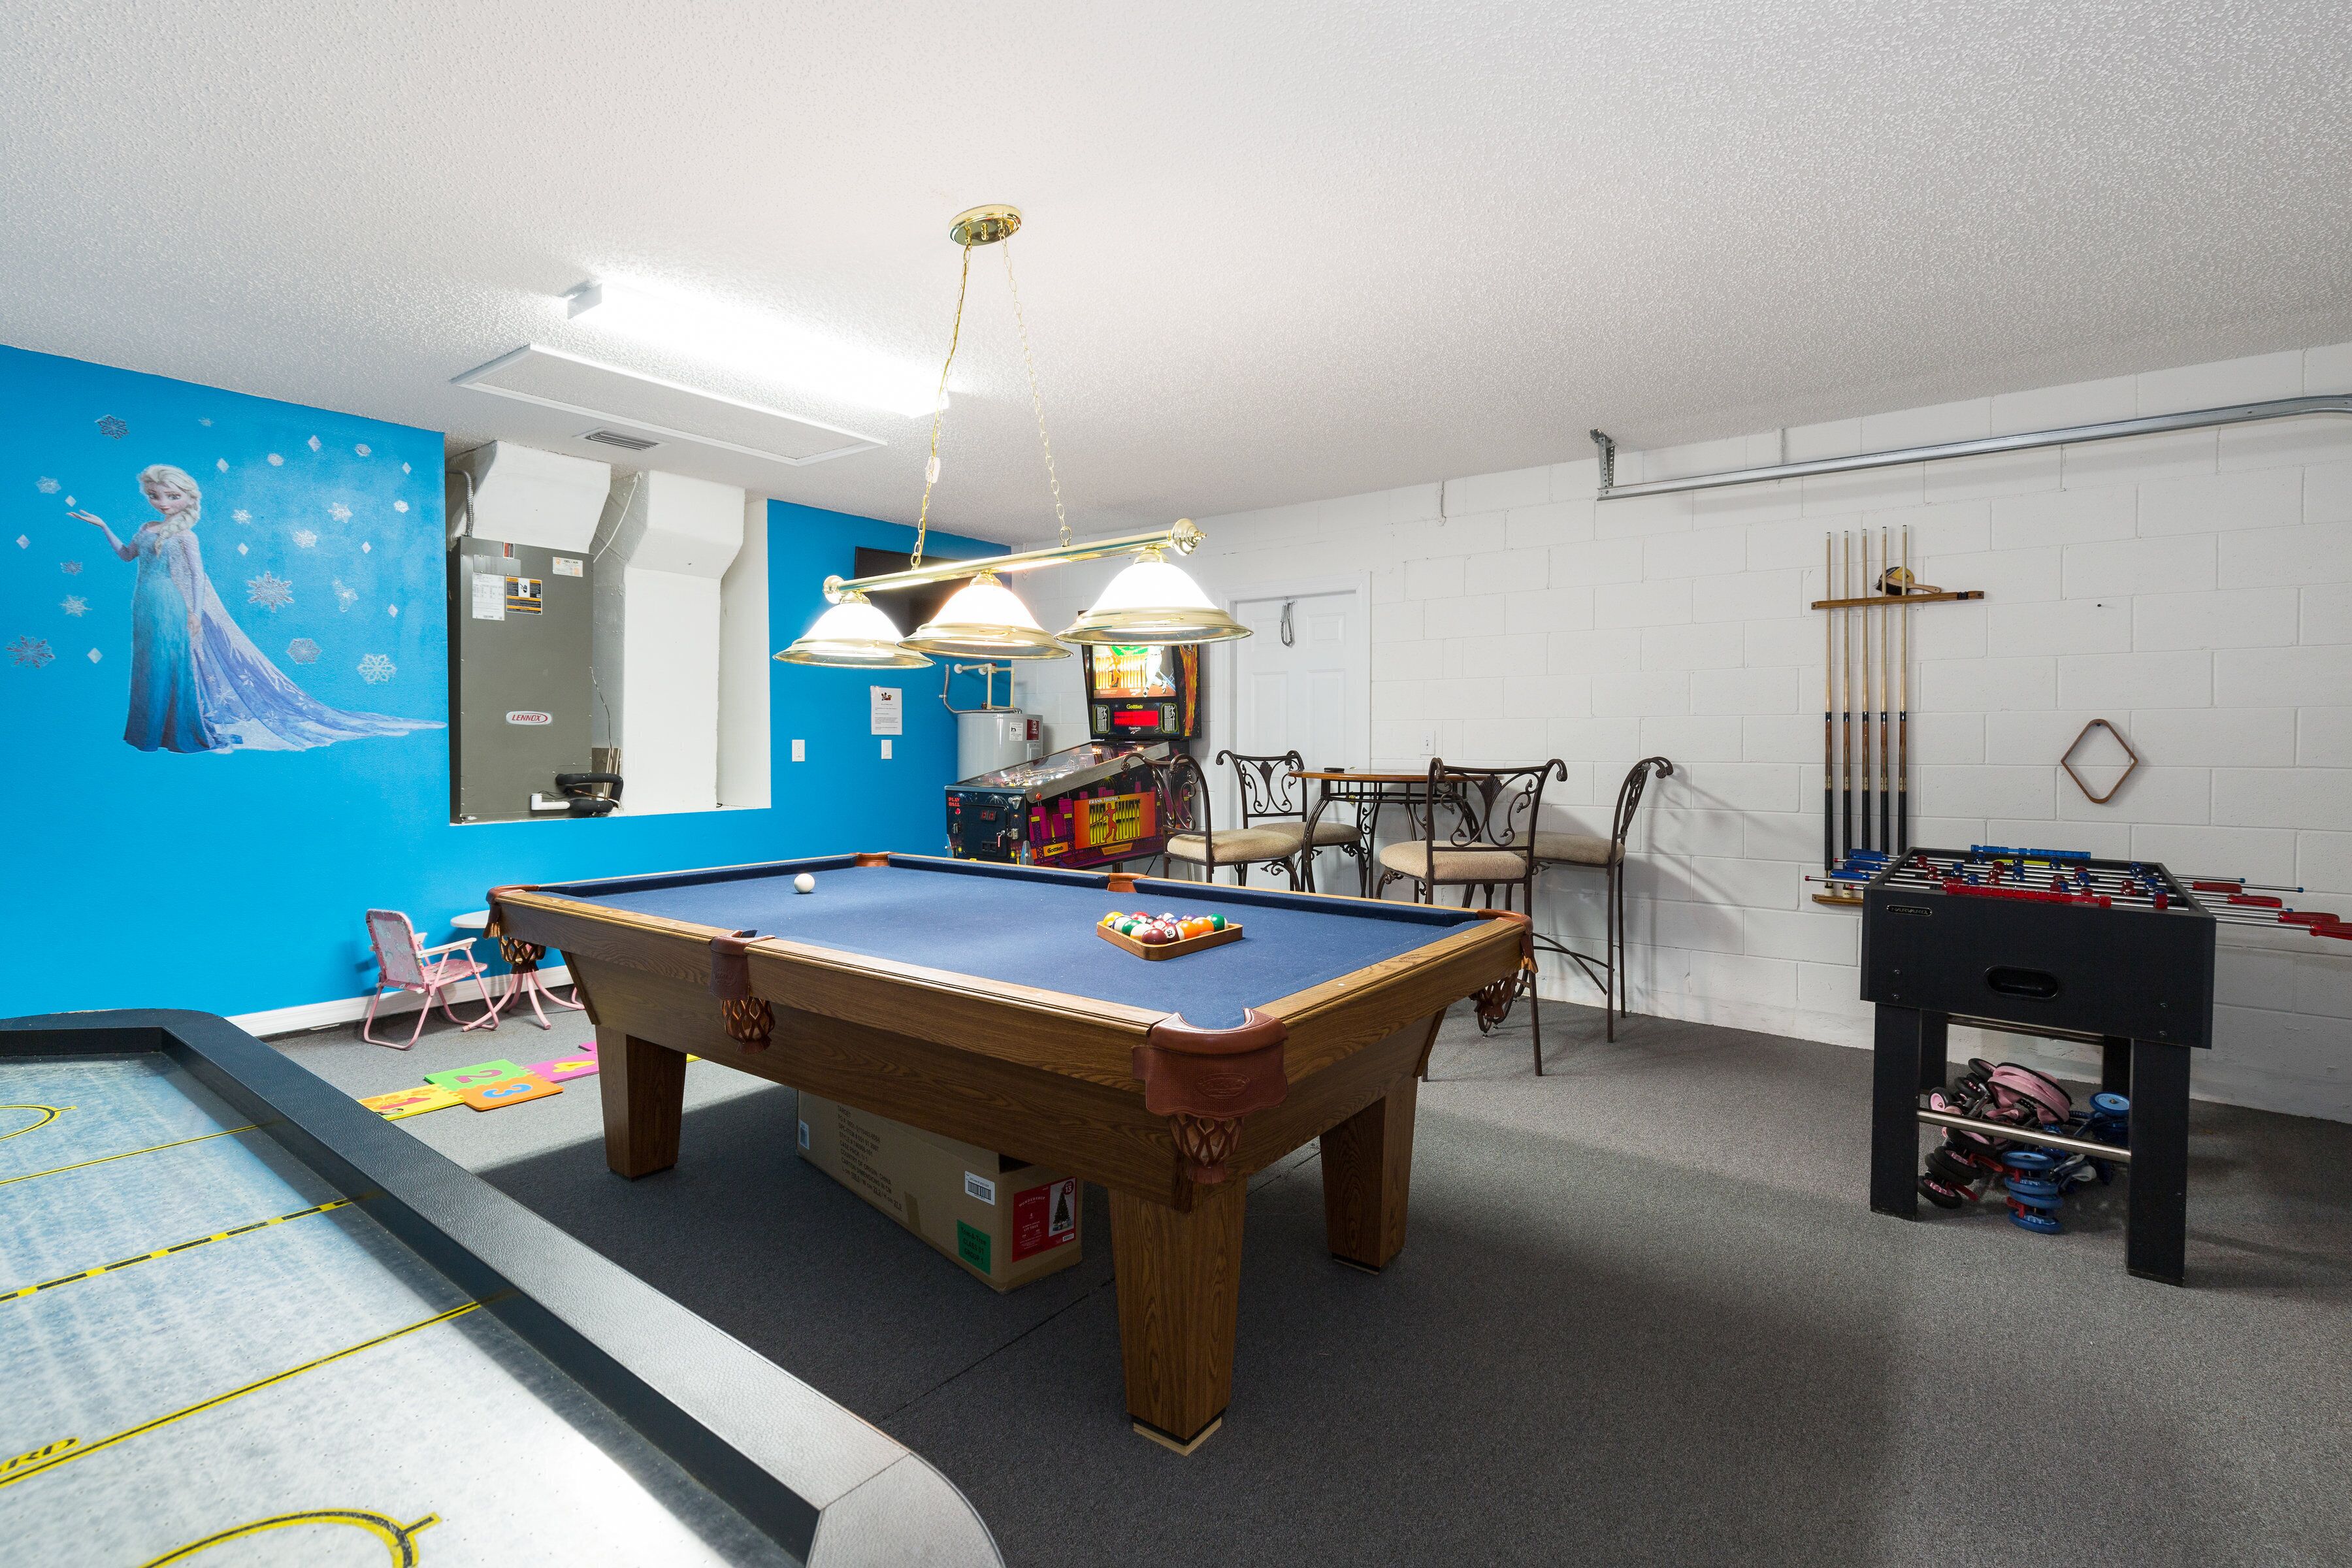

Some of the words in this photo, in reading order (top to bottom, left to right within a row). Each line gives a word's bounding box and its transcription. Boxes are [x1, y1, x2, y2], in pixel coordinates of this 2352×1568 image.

[453, 1069, 504, 1085] 2
[482, 1084, 532, 1099] 3
[838, 1105, 851, 1119] TARGET
[841, 1149, 857, 1164] COUNTRY
[879, 1173, 891, 1186] CHINA
[841, 1157, 856, 1172] CARTON
[857, 1166, 880, 1187] DIMENSIONS
[963, 1238, 978, 1251] CLASS
[964, 1248, 980, 1261] GROUP
